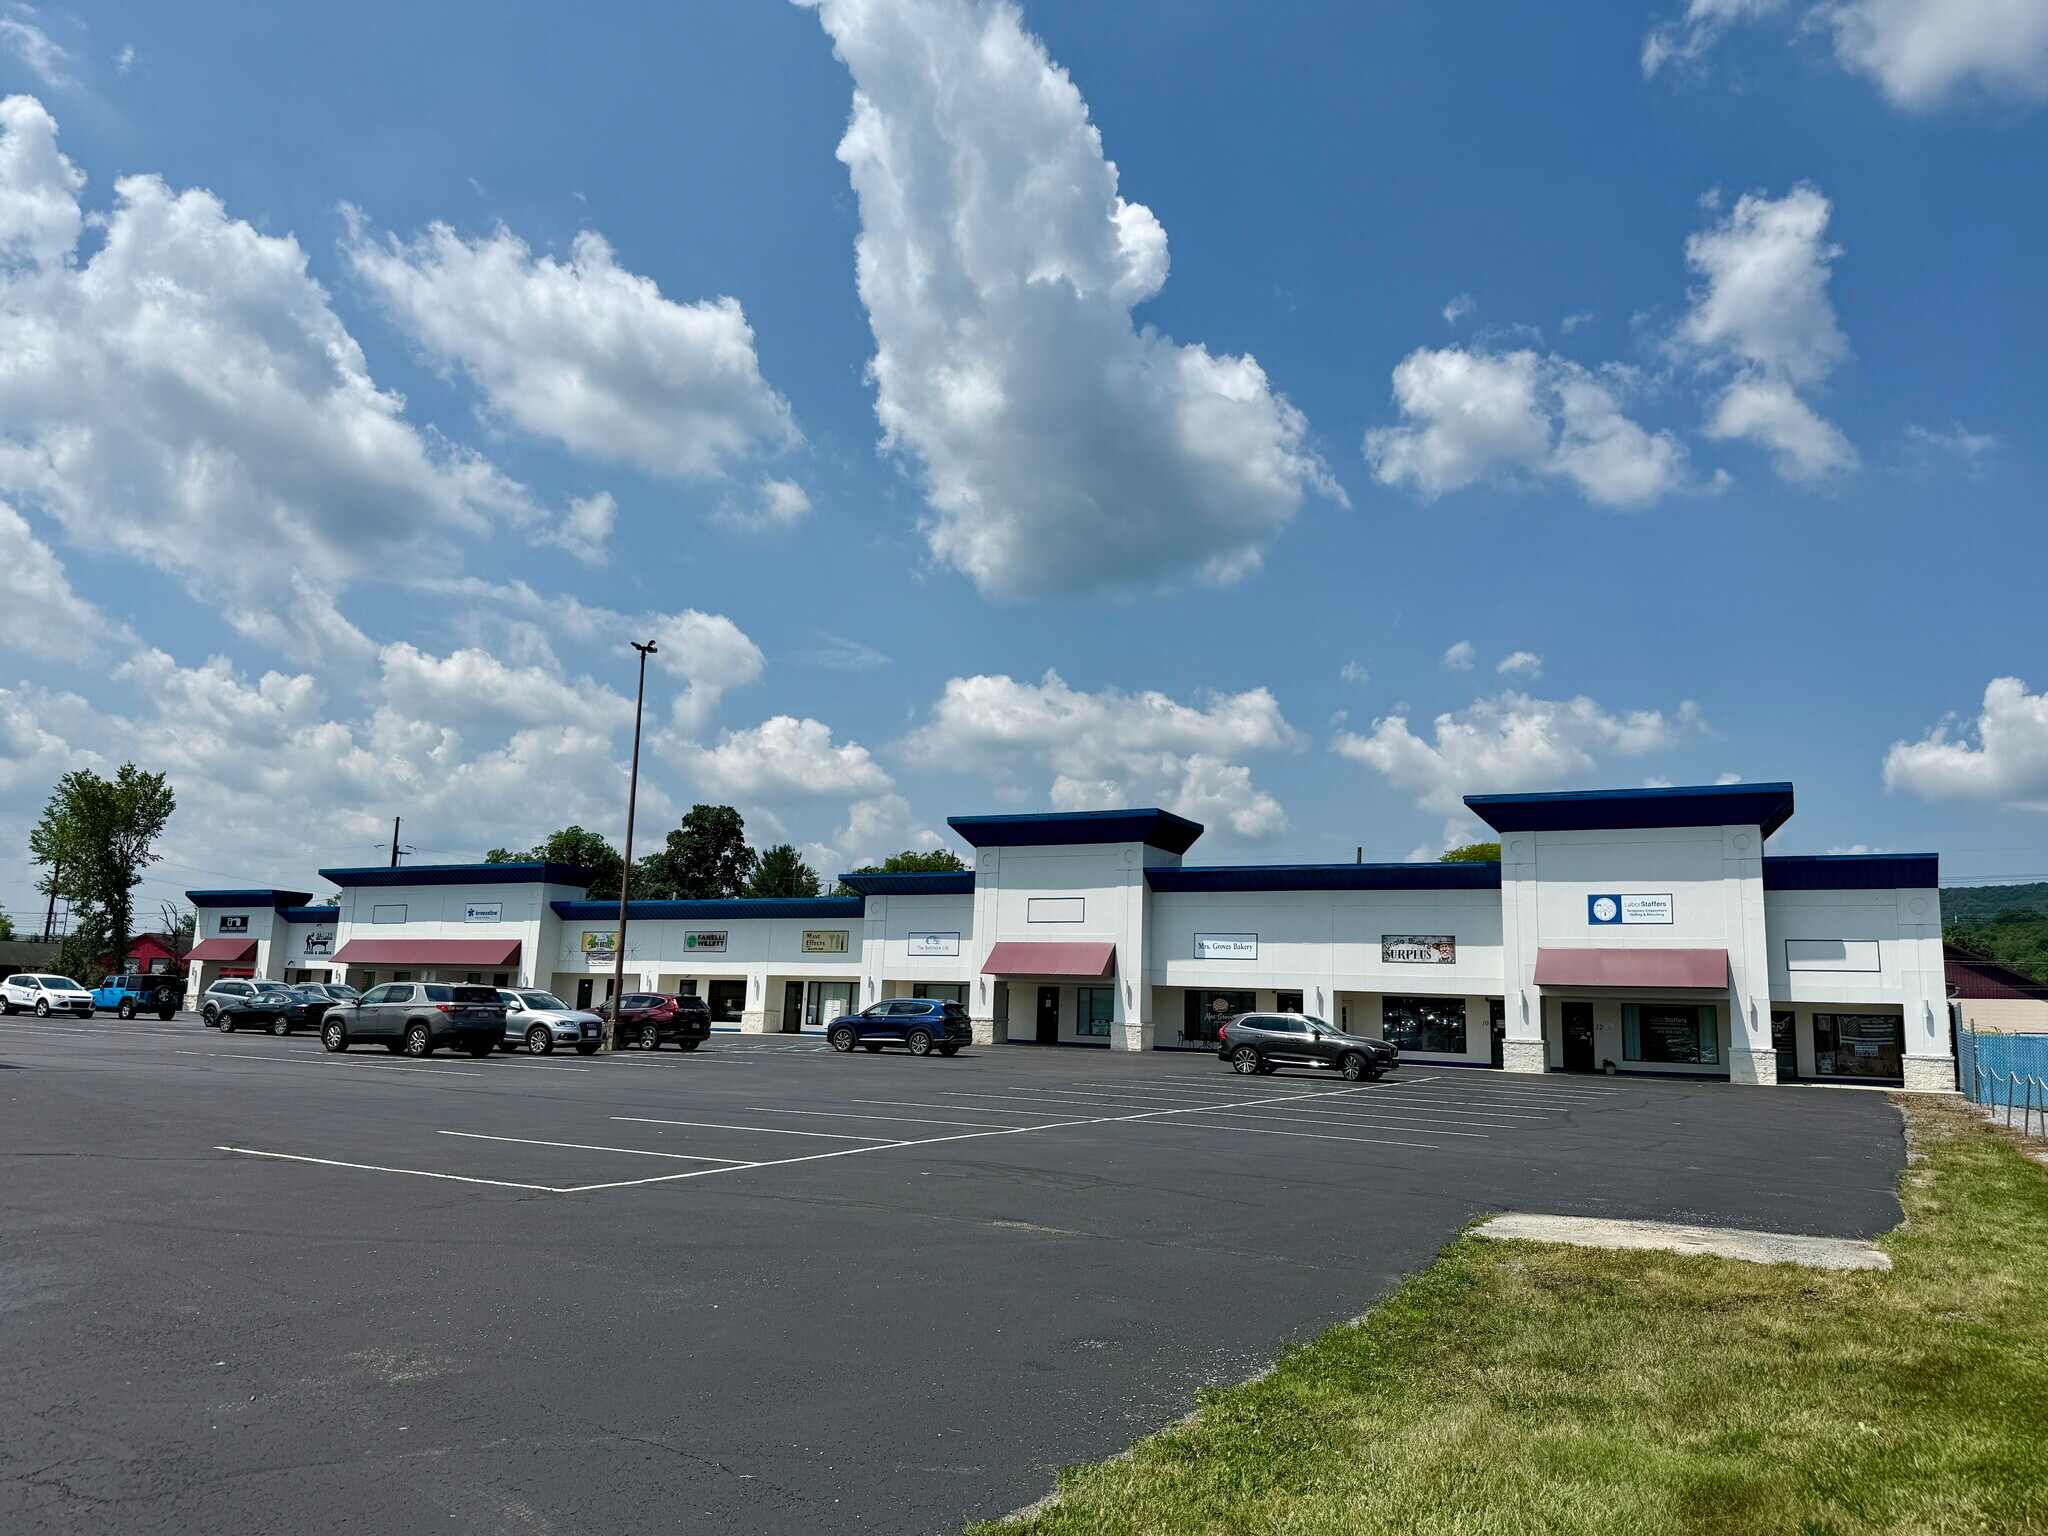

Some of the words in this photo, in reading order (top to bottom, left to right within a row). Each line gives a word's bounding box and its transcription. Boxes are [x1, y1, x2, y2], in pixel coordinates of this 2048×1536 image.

[1198, 942, 1211, 950] Mrs.
[1212, 942, 1232, 950] Groves
[1233, 942, 1253, 952] Bakery
[1385, 949, 1432, 960] SURPLUS
[1595, 1023, 1603, 1031] 12
